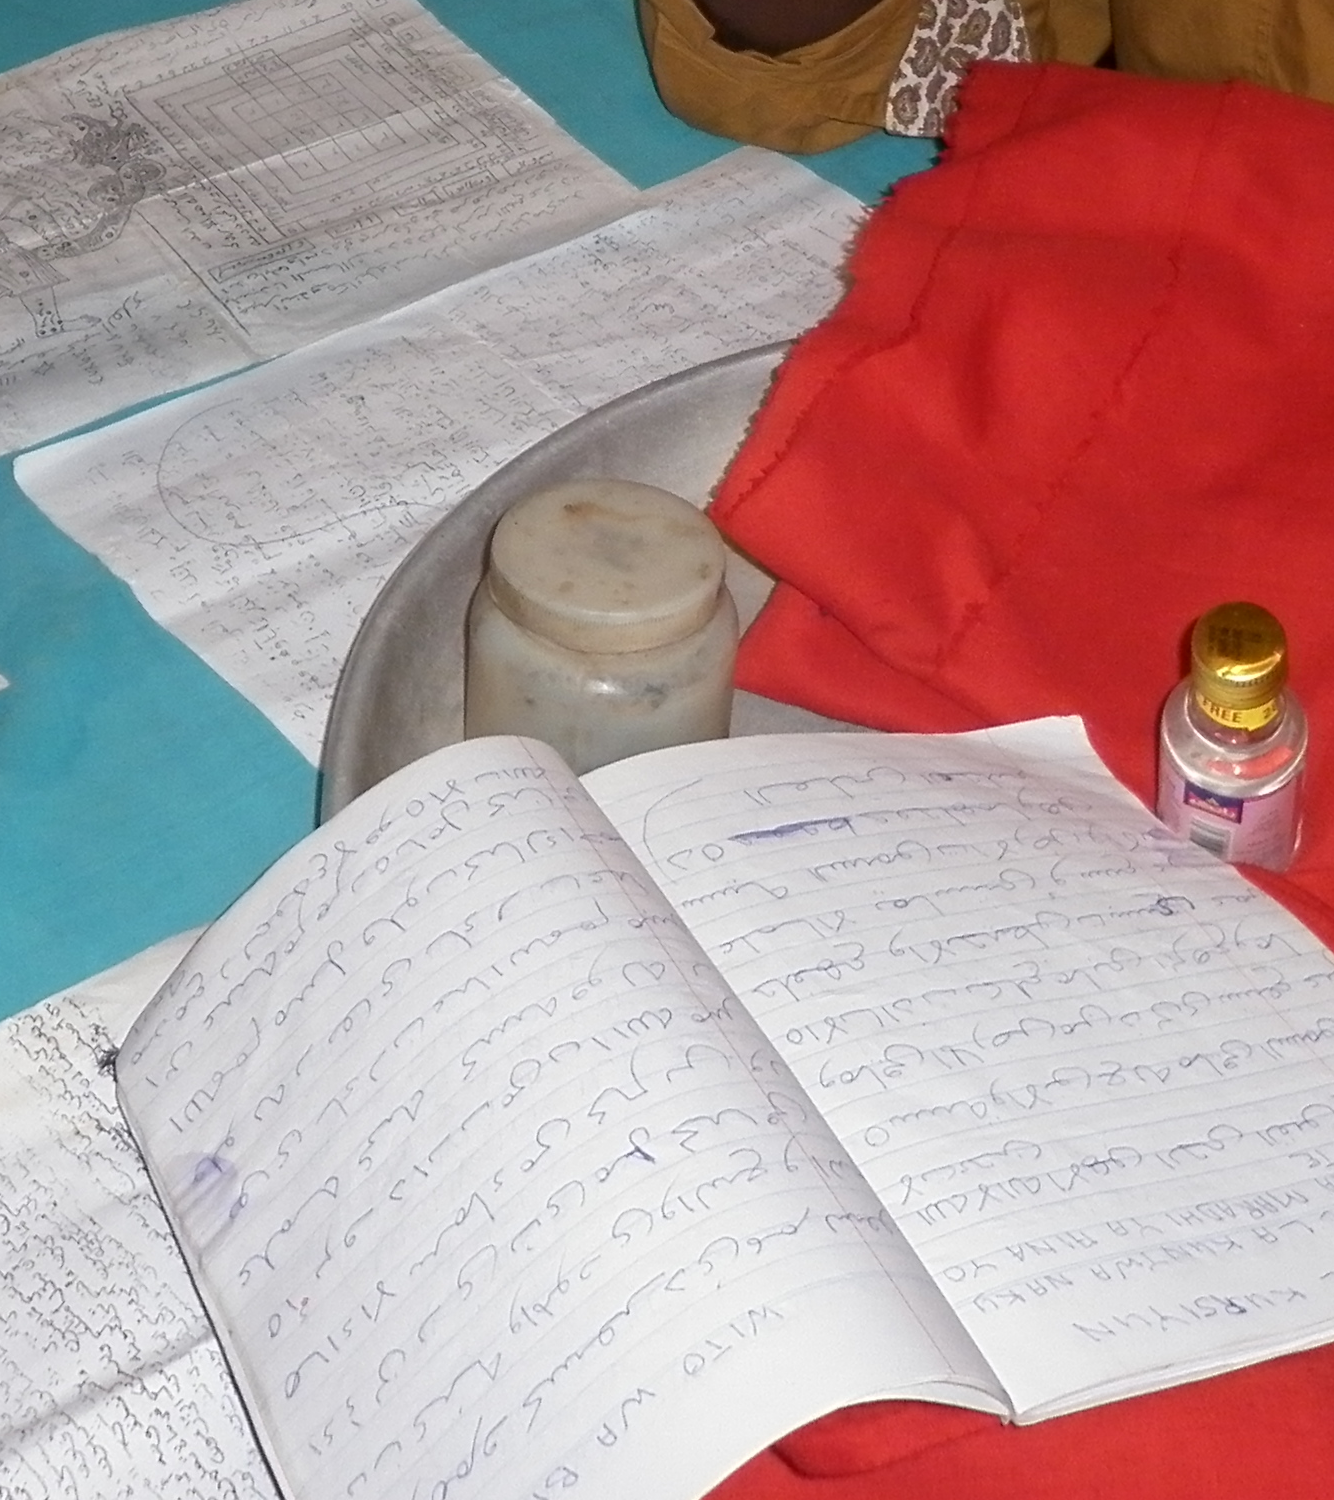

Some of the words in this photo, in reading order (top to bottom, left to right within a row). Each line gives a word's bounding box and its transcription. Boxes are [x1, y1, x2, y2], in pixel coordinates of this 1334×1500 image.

[1103, 1212, 1165, 1239] YA
[1165, 1188, 1311, 1228] MARADHI
[1249, 1217, 1316, 1246] LA
[681, 1302, 786, 1379] WITO
[595, 1386, 658, 1449] WA
